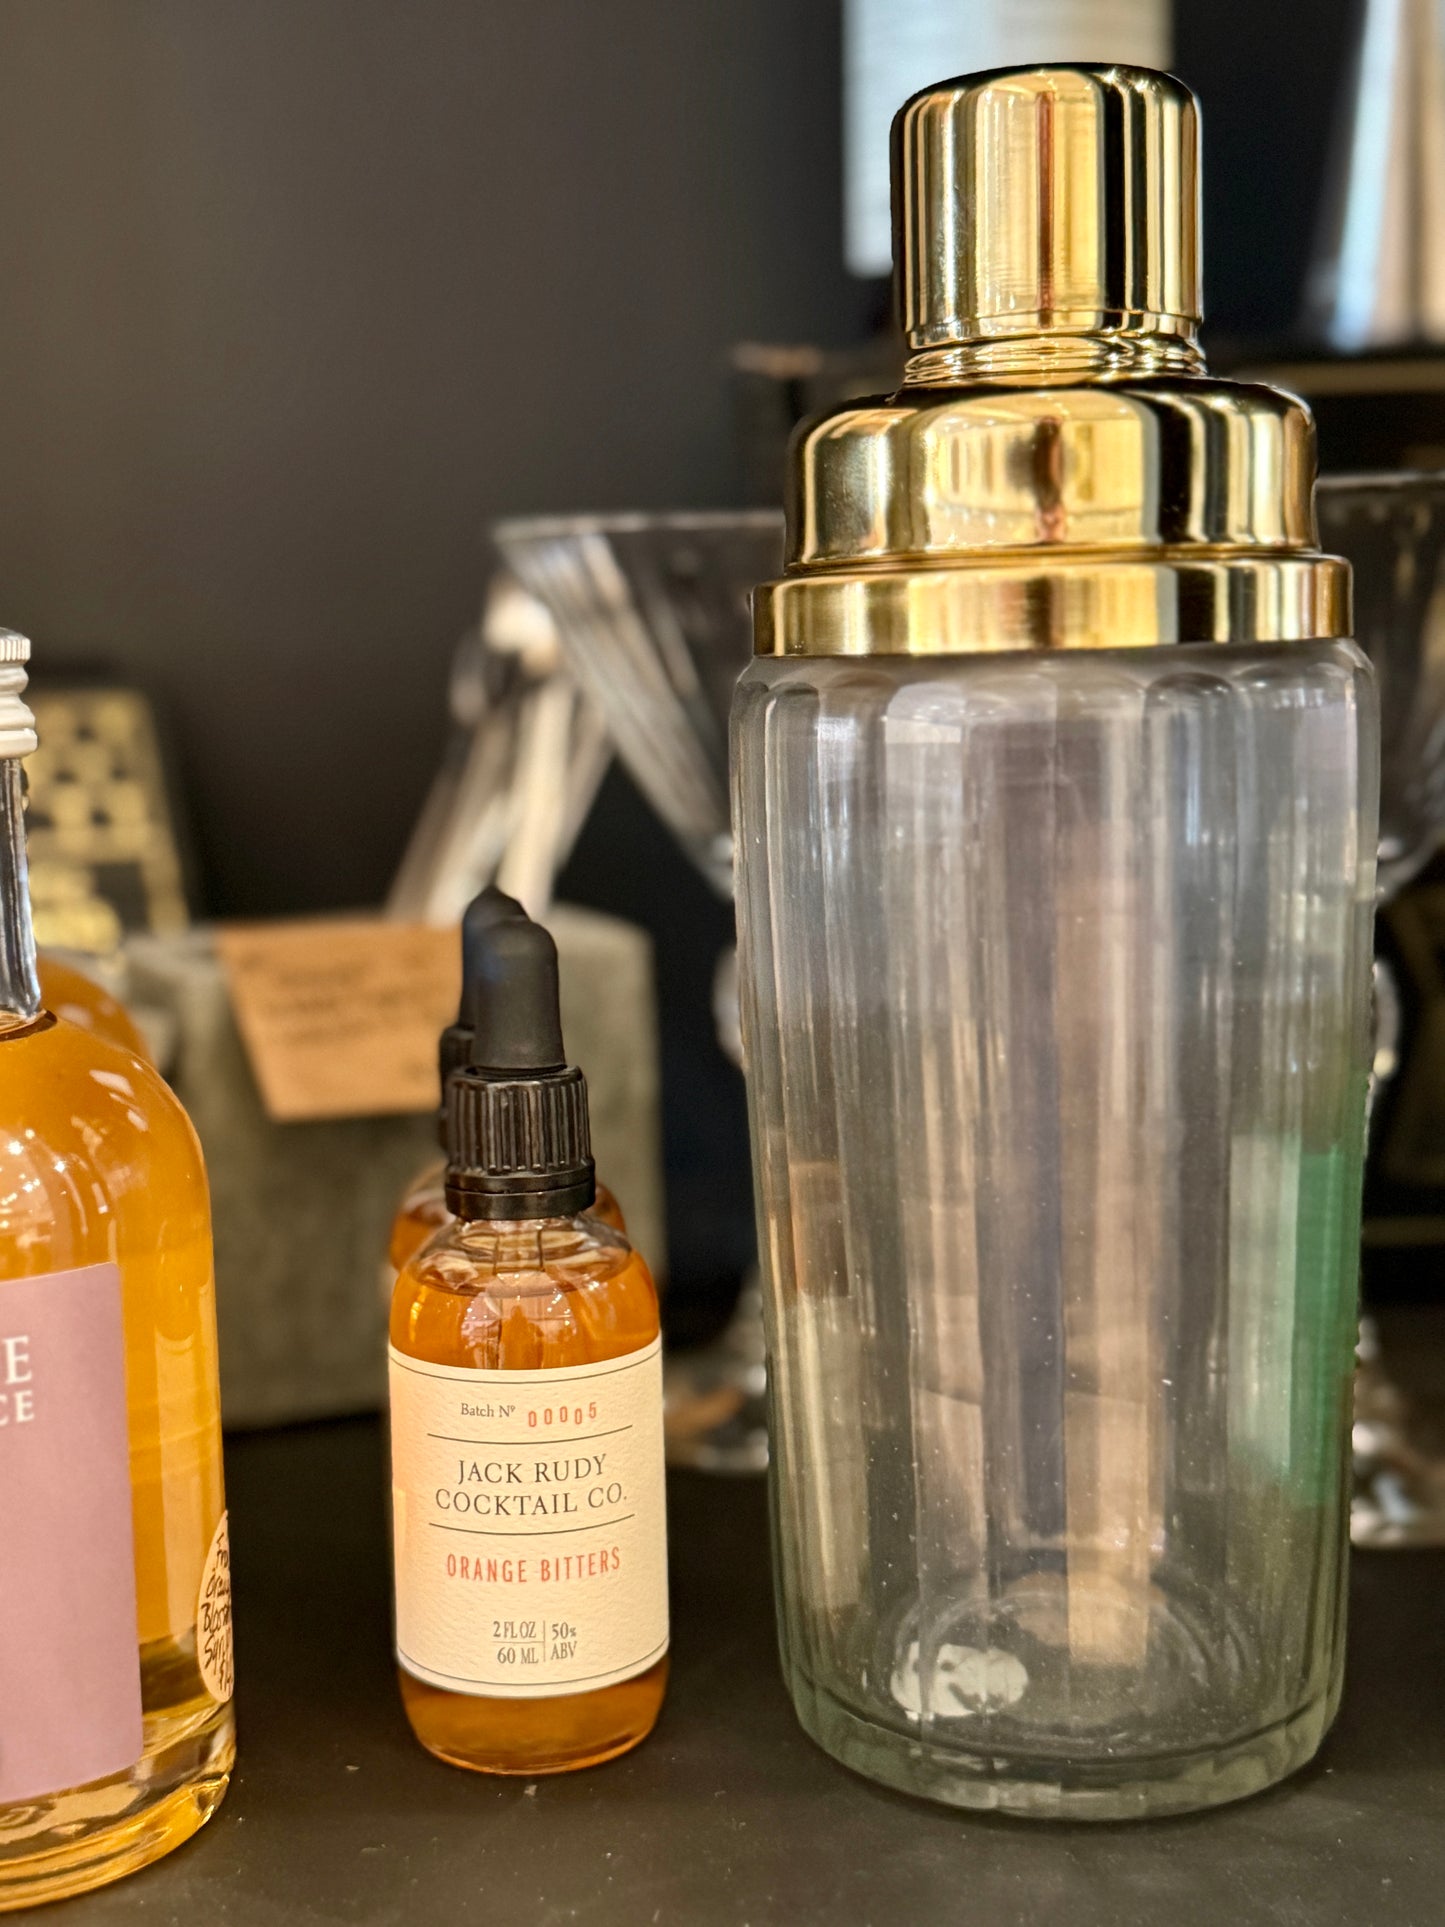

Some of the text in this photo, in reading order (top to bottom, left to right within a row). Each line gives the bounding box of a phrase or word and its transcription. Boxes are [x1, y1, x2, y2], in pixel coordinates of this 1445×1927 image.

[460, 1402, 495, 1418] Batch
[528, 1401, 598, 1428] 00005
[457, 1453, 607, 1485] JACK RUDY
[435, 1482, 628, 1516] COCKTAIL CO.
[447, 1546, 620, 1583] ORANGE BITTERS
[493, 1620, 537, 1639] 2 FL OZ
[551, 1621, 577, 1641] 50%
[497, 1646, 540, 1665] 60 ML
[550, 1640, 578, 1661] ABV
